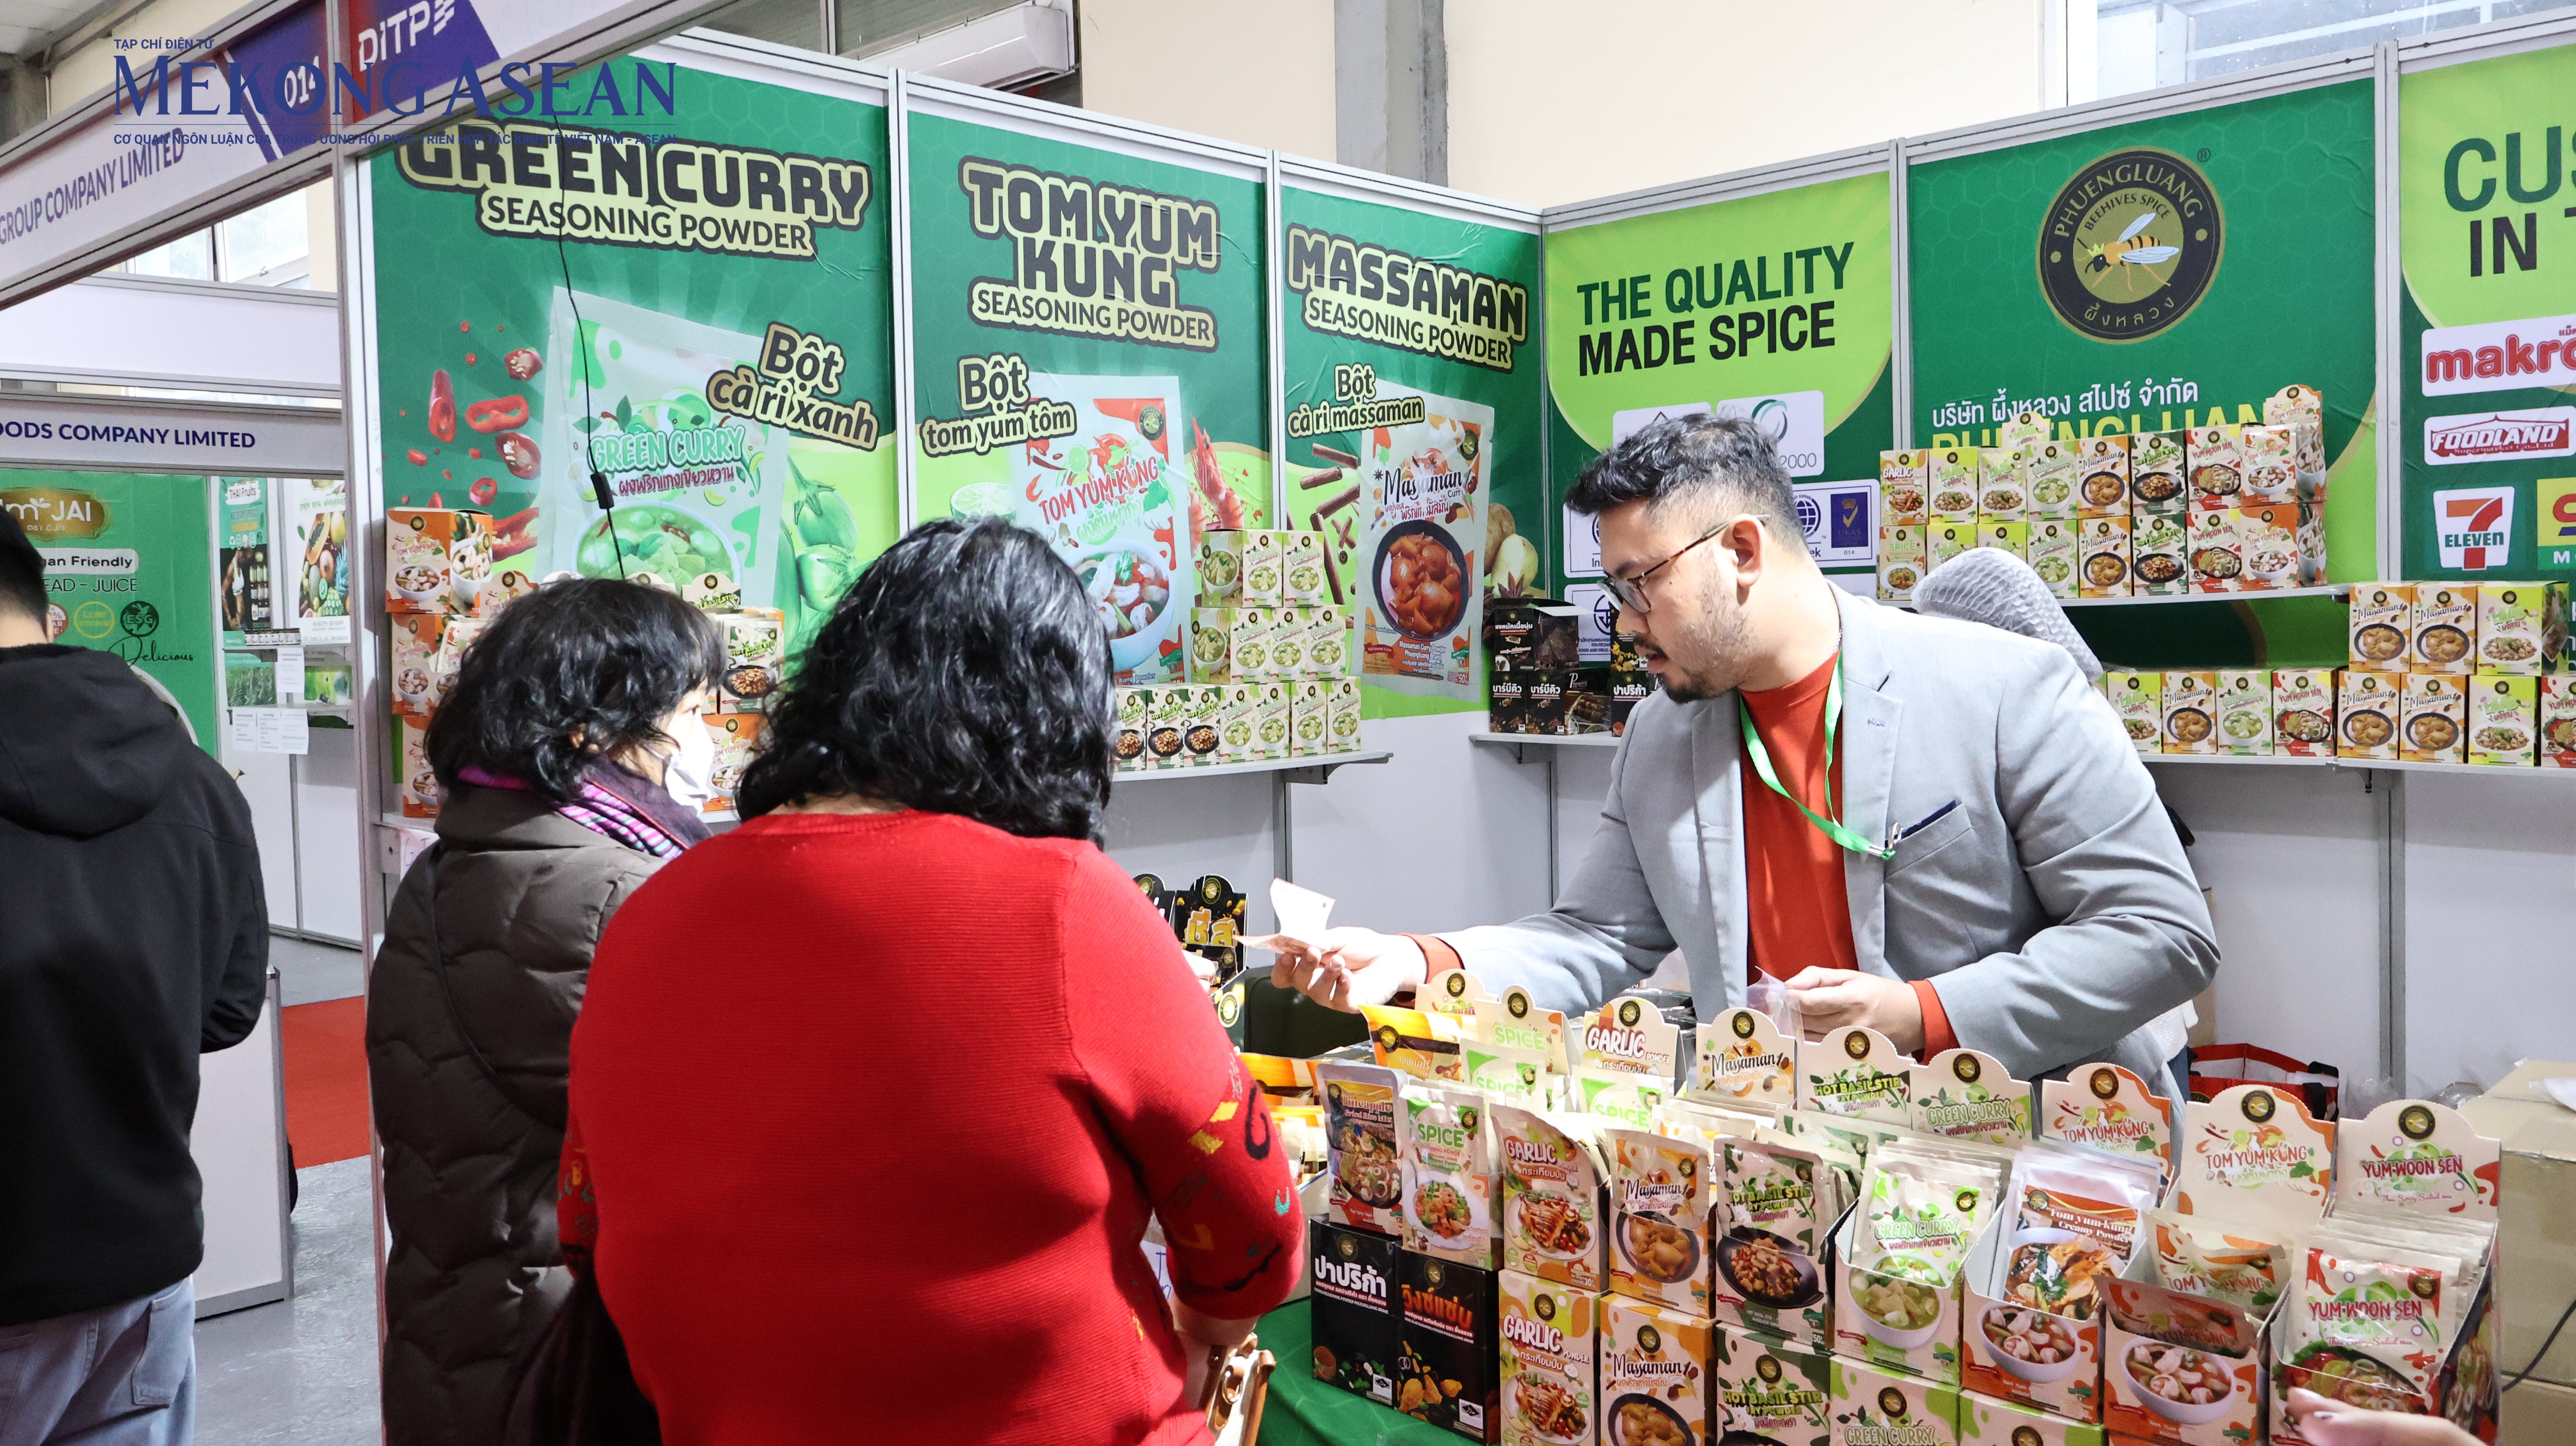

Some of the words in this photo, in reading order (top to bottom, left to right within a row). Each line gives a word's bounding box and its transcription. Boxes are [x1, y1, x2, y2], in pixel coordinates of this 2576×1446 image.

[358, 0, 431, 72] DITP
[407, 125, 643, 199] GREEN
[663, 149, 863, 220] CURRY
[2444, 126, 2576, 212] CU
[0, 197, 42, 245] GROUP
[46, 160, 116, 220] COMPANY
[120, 128, 184, 188] LIMITED
[2054, 163, 2203, 237] PHUENGLUANG
[2084, 193, 2137, 231] BEEHIVES
[2140, 194, 2171, 220] SPICE
[489, 196, 671, 238] SEASONING
[681, 215, 808, 250] POWDER
[969, 169, 1088, 240] TOM
[1104, 197, 1212, 262] YUM
[2470, 213, 2537, 277] IN
[1023, 237, 1170, 308] KUNG
[1577, 274, 1651, 325] THE
[1665, 242, 1854, 313] QUALITY
[1293, 234, 1523, 336] MASSAMAN
[978, 289, 1111, 328] SEASONING
[1118, 308, 1210, 341] POWDER
[2084, 297, 2176, 328] ผึ้งหลวง
[1310, 297, 1423, 343] SEASONING
[1429, 327, 1509, 364] POWDER
[1580, 320, 1695, 376] MADE
[1710, 301, 1835, 360] SPICE
[766, 328, 838, 391] Bột
[964, 361, 1022, 412] Bột
[1337, 367, 1373, 403] Bột
[714, 376, 751, 410] cà
[760, 382, 787, 418] ri
[792, 395, 873, 444] xanh
[1933, 400, 1984, 428] บริษัท
[2079, 380, 2132, 414] สไปซ์
[2140, 378, 2198, 409] จำกัด
[1291, 405, 1309, 433] cà
[1316, 405, 1328, 430] ri
[1334, 398, 1422, 427] massaman
[59, 424, 169, 444] COMPANY
[175, 430, 255, 448] LIMITED
[927, 422, 972, 449] tom
[976, 416, 1025, 451] yum
[1031, 407, 1071, 433] tôm
[2432, 424, 2560, 451] FOODLAND
[592, 432, 667, 470] GREEN
[670, 426, 744, 466] CURRY
[1883, 467, 1913, 479] GARLIC
[2084, 453, 2117, 469] Massaman
[1384, 468, 1462, 505] Massaman
[51, 500, 91, 522] JAI
[1039, 491, 1075, 525] TOM
[1889, 542, 1915, 552] SPICE
[2086, 534, 2120, 550] Massaman
[71, 556, 132, 568] Friendly
[93, 578, 137, 592] JUICE
[126, 614, 153, 625] ESG
[2358, 604, 2399, 620] Massaman
[2421, 605, 2463, 621] Massaman
[109, 636, 194, 666] Delicious
[1134, 672, 1156, 681] Powder
[2169, 690, 2204, 704] Massaman
[2347, 691, 2388, 706] Massaman
[2410, 693, 2451, 708] Massaman
[1494, 1026, 1546, 1051] SPICE
[1587, 1025, 1646, 1058] GARLIC
[1646, 1051, 1671, 1065] POWDER
[1711, 1053, 1776, 1077] Massaman
[1814, 1083, 1838, 1097] HOT
[1839, 1080, 1871, 1094] BASIL
[1874, 1076, 1902, 1089] STIR
[1927, 1104, 1967, 1126] GREEN
[1968, 1099, 2011, 1121] CURRY
[1418, 1124, 1465, 1148] SPICE
[2062, 1129, 2087, 1143] TOM
[1505, 1139, 1557, 1163] GARLIC
[2205, 1152, 2233, 1170] TOM
[2438, 1156, 2463, 1173] SEN
[1625, 1179, 1682, 1200] Massaman
[1748, 1188, 1784, 1203] BASIL
[2418, 1192, 2440, 1202] Salad
[2050, 1209, 2075, 1221] Tom
[1875, 1221, 1916, 1239] GREEN
[1917, 1218, 1959, 1238] CURRY
[2058, 1220, 2093, 1235] Creamy
[2095, 1228, 2130, 1243] Powder
[1315, 1255, 1386, 1298] ปาปริก้า
[2394, 1300, 2423, 1318] SEN
[1503, 1314, 1563, 1353] GARLIC
[2372, 1336, 2398, 1346] Salad
[1563, 1349, 1589, 1364] POWDER
[1613, 1353, 1682, 1378] Massaman
[1722, 1391, 1747, 1404] HOT
[1749, 1392, 1787, 1405] BASIL
[1789, 1391, 1823, 1404] STIR
[1845, 1425, 1889, 1446] GREEN
[1889, 1425, 1935, 1446] CURRY
